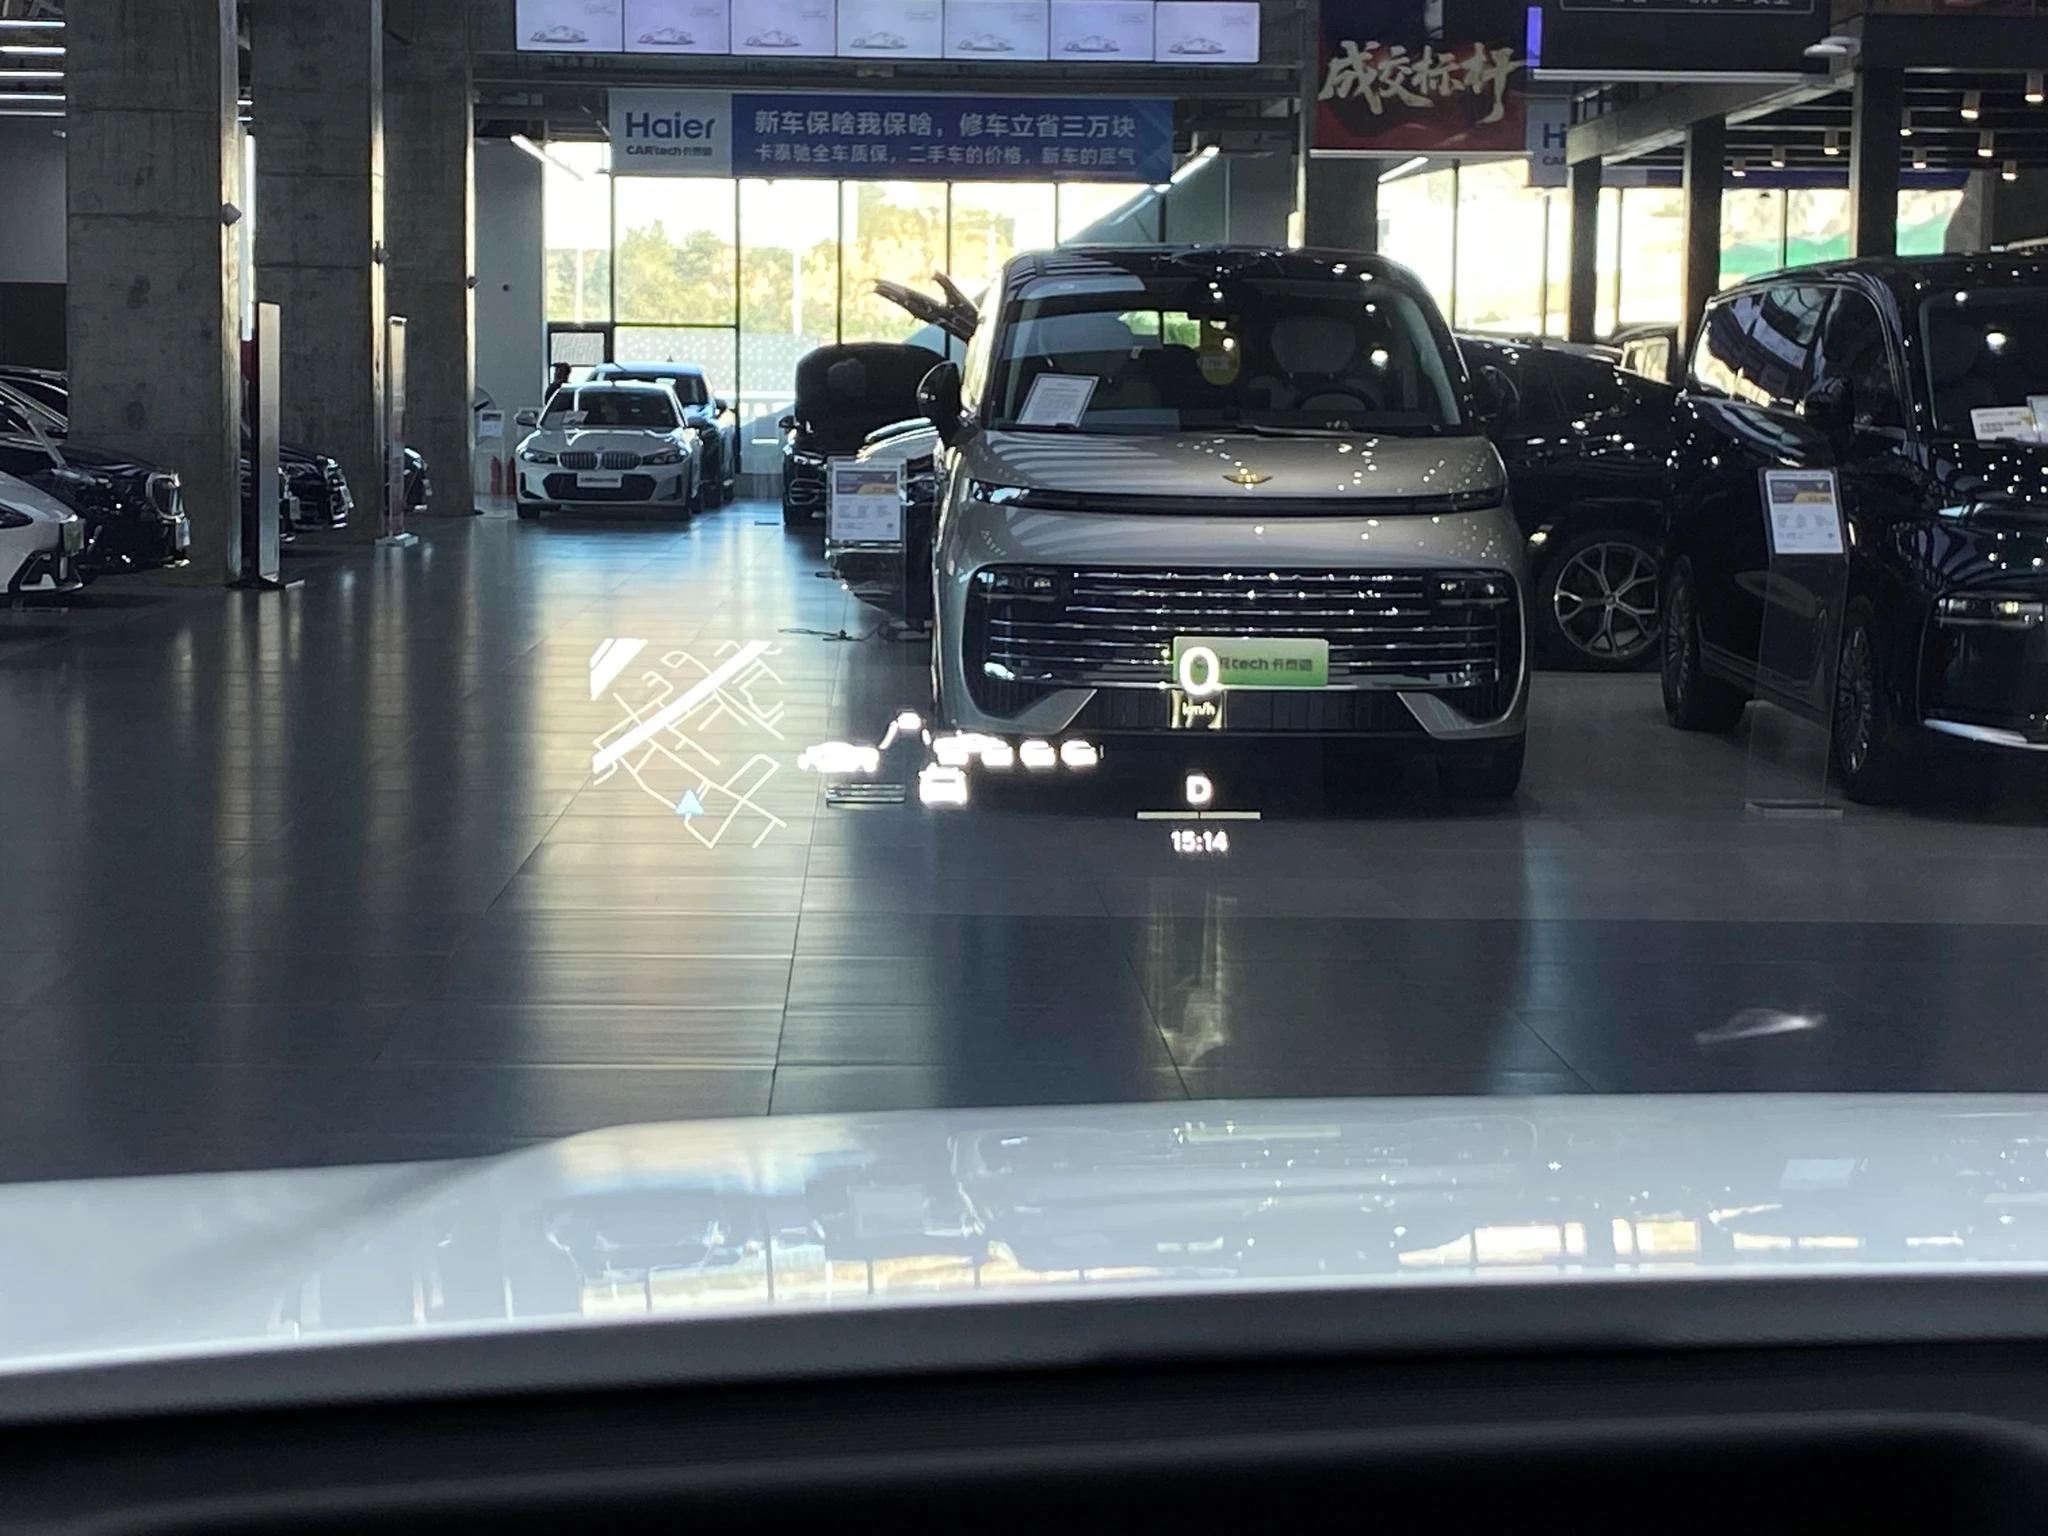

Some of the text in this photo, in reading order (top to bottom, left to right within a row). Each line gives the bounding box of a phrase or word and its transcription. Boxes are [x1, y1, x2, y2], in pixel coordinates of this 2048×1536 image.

[1318, 41, 1527, 123] 成交标杆
[626, 112, 716, 139] Haier
[1180, 647, 1219, 695] 0
[1182, 702, 1216, 716] km/h
[1186, 775, 1212, 804] D
[1170, 830, 1228, 852] 15:14
